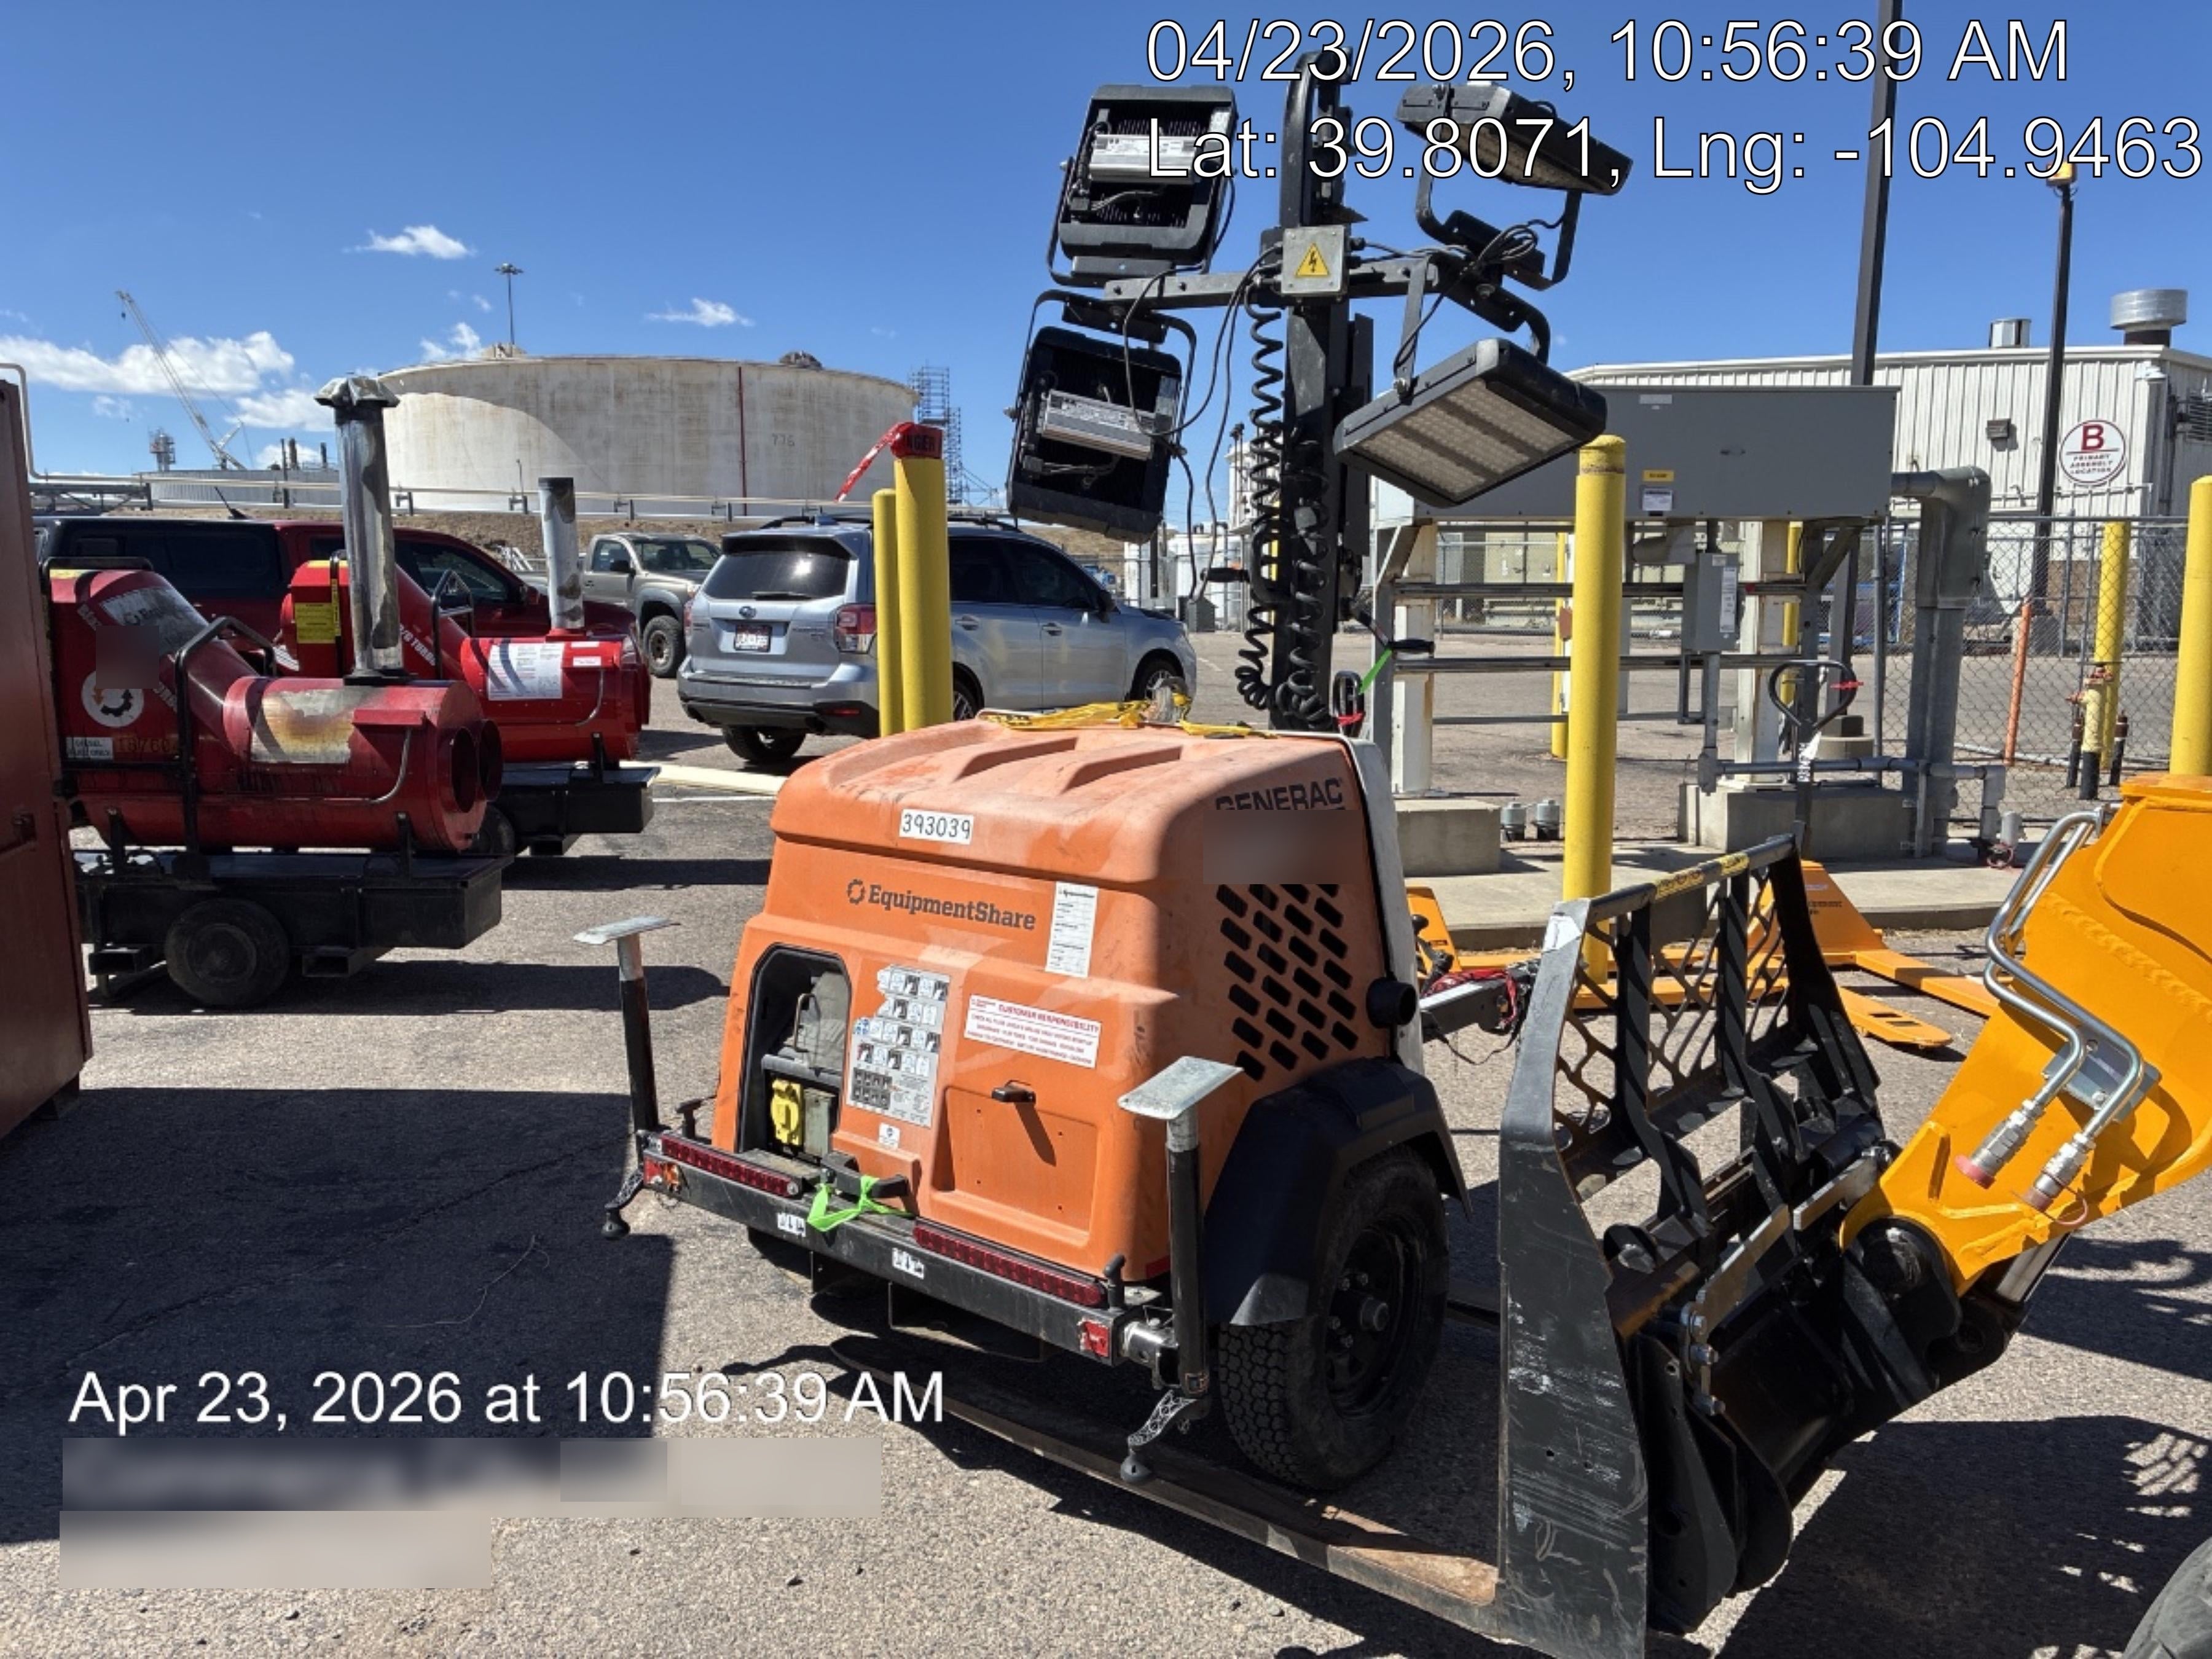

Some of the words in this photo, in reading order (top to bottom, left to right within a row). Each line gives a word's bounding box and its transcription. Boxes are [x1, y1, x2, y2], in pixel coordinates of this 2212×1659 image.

[2081, 424, 2104, 451] B
[902, 813, 971, 839] 393039
[868, 884, 1037, 930] EquipmentShare
